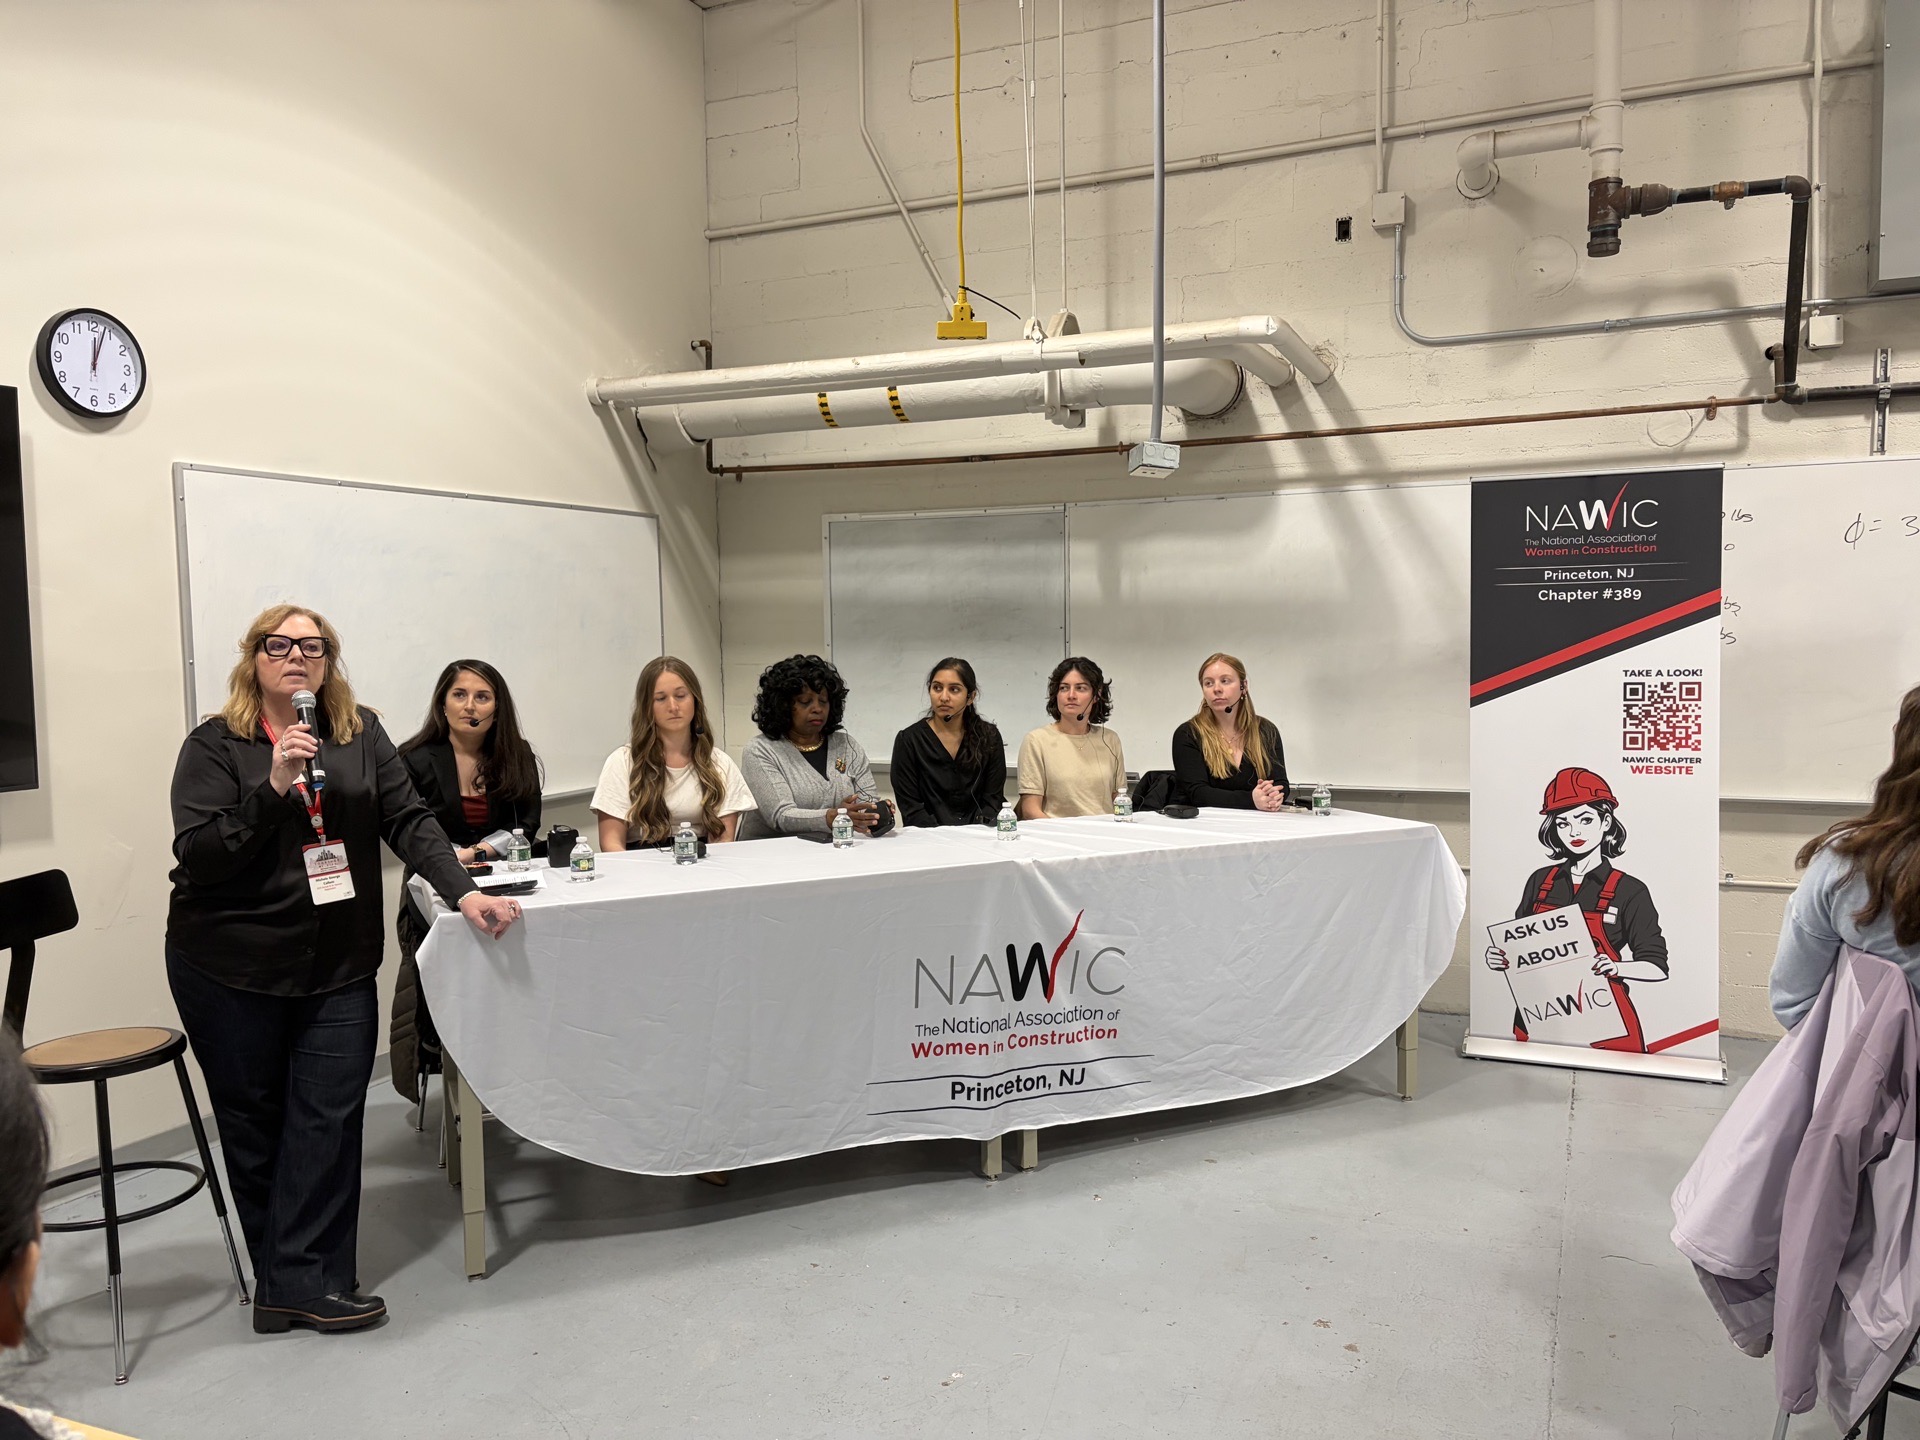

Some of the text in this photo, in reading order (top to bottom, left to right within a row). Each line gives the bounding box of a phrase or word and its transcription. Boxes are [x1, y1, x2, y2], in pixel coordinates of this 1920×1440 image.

[72, 321, 81, 334] 11
[87, 320, 99, 333] 12
[57, 332, 69, 345] 10
[108, 330, 113, 340] 1
[119, 344, 127, 356] 2
[54, 351, 62, 363] 9
[124, 365, 131, 376] 3
[59, 371, 67, 383] 8
[73, 386, 80, 398] 7
[120, 383, 127, 393] 4
[91, 395, 98, 407] 6
[108, 393, 115, 405] 5
[1526, 481, 1659, 531] NAWIC
[1541, 535, 1585, 545] National
[1587, 533, 1647, 544] Association
[1525, 548, 1568, 556] Women
[1581, 544, 1657, 555] Construction
[1545, 568, 1634, 580] Princeton, NJ
[1539, 588, 1641, 602] Chapter #389
[1667, 669, 1702, 677] LOOK!
[1630, 765, 1693, 775] WEBSITE
[1504, 915, 1568, 943] ASK US
[915, 909, 1125, 1009] NAWIC
[1516, 941, 1579, 968] ABOUT
[1523, 978, 1612, 1024] NAWIC
[915, 1005, 1120, 1037] The National Association of
[911, 1026, 1118, 1058] Women in Construction
[951, 1068, 1085, 1101] Princeton, NJ
